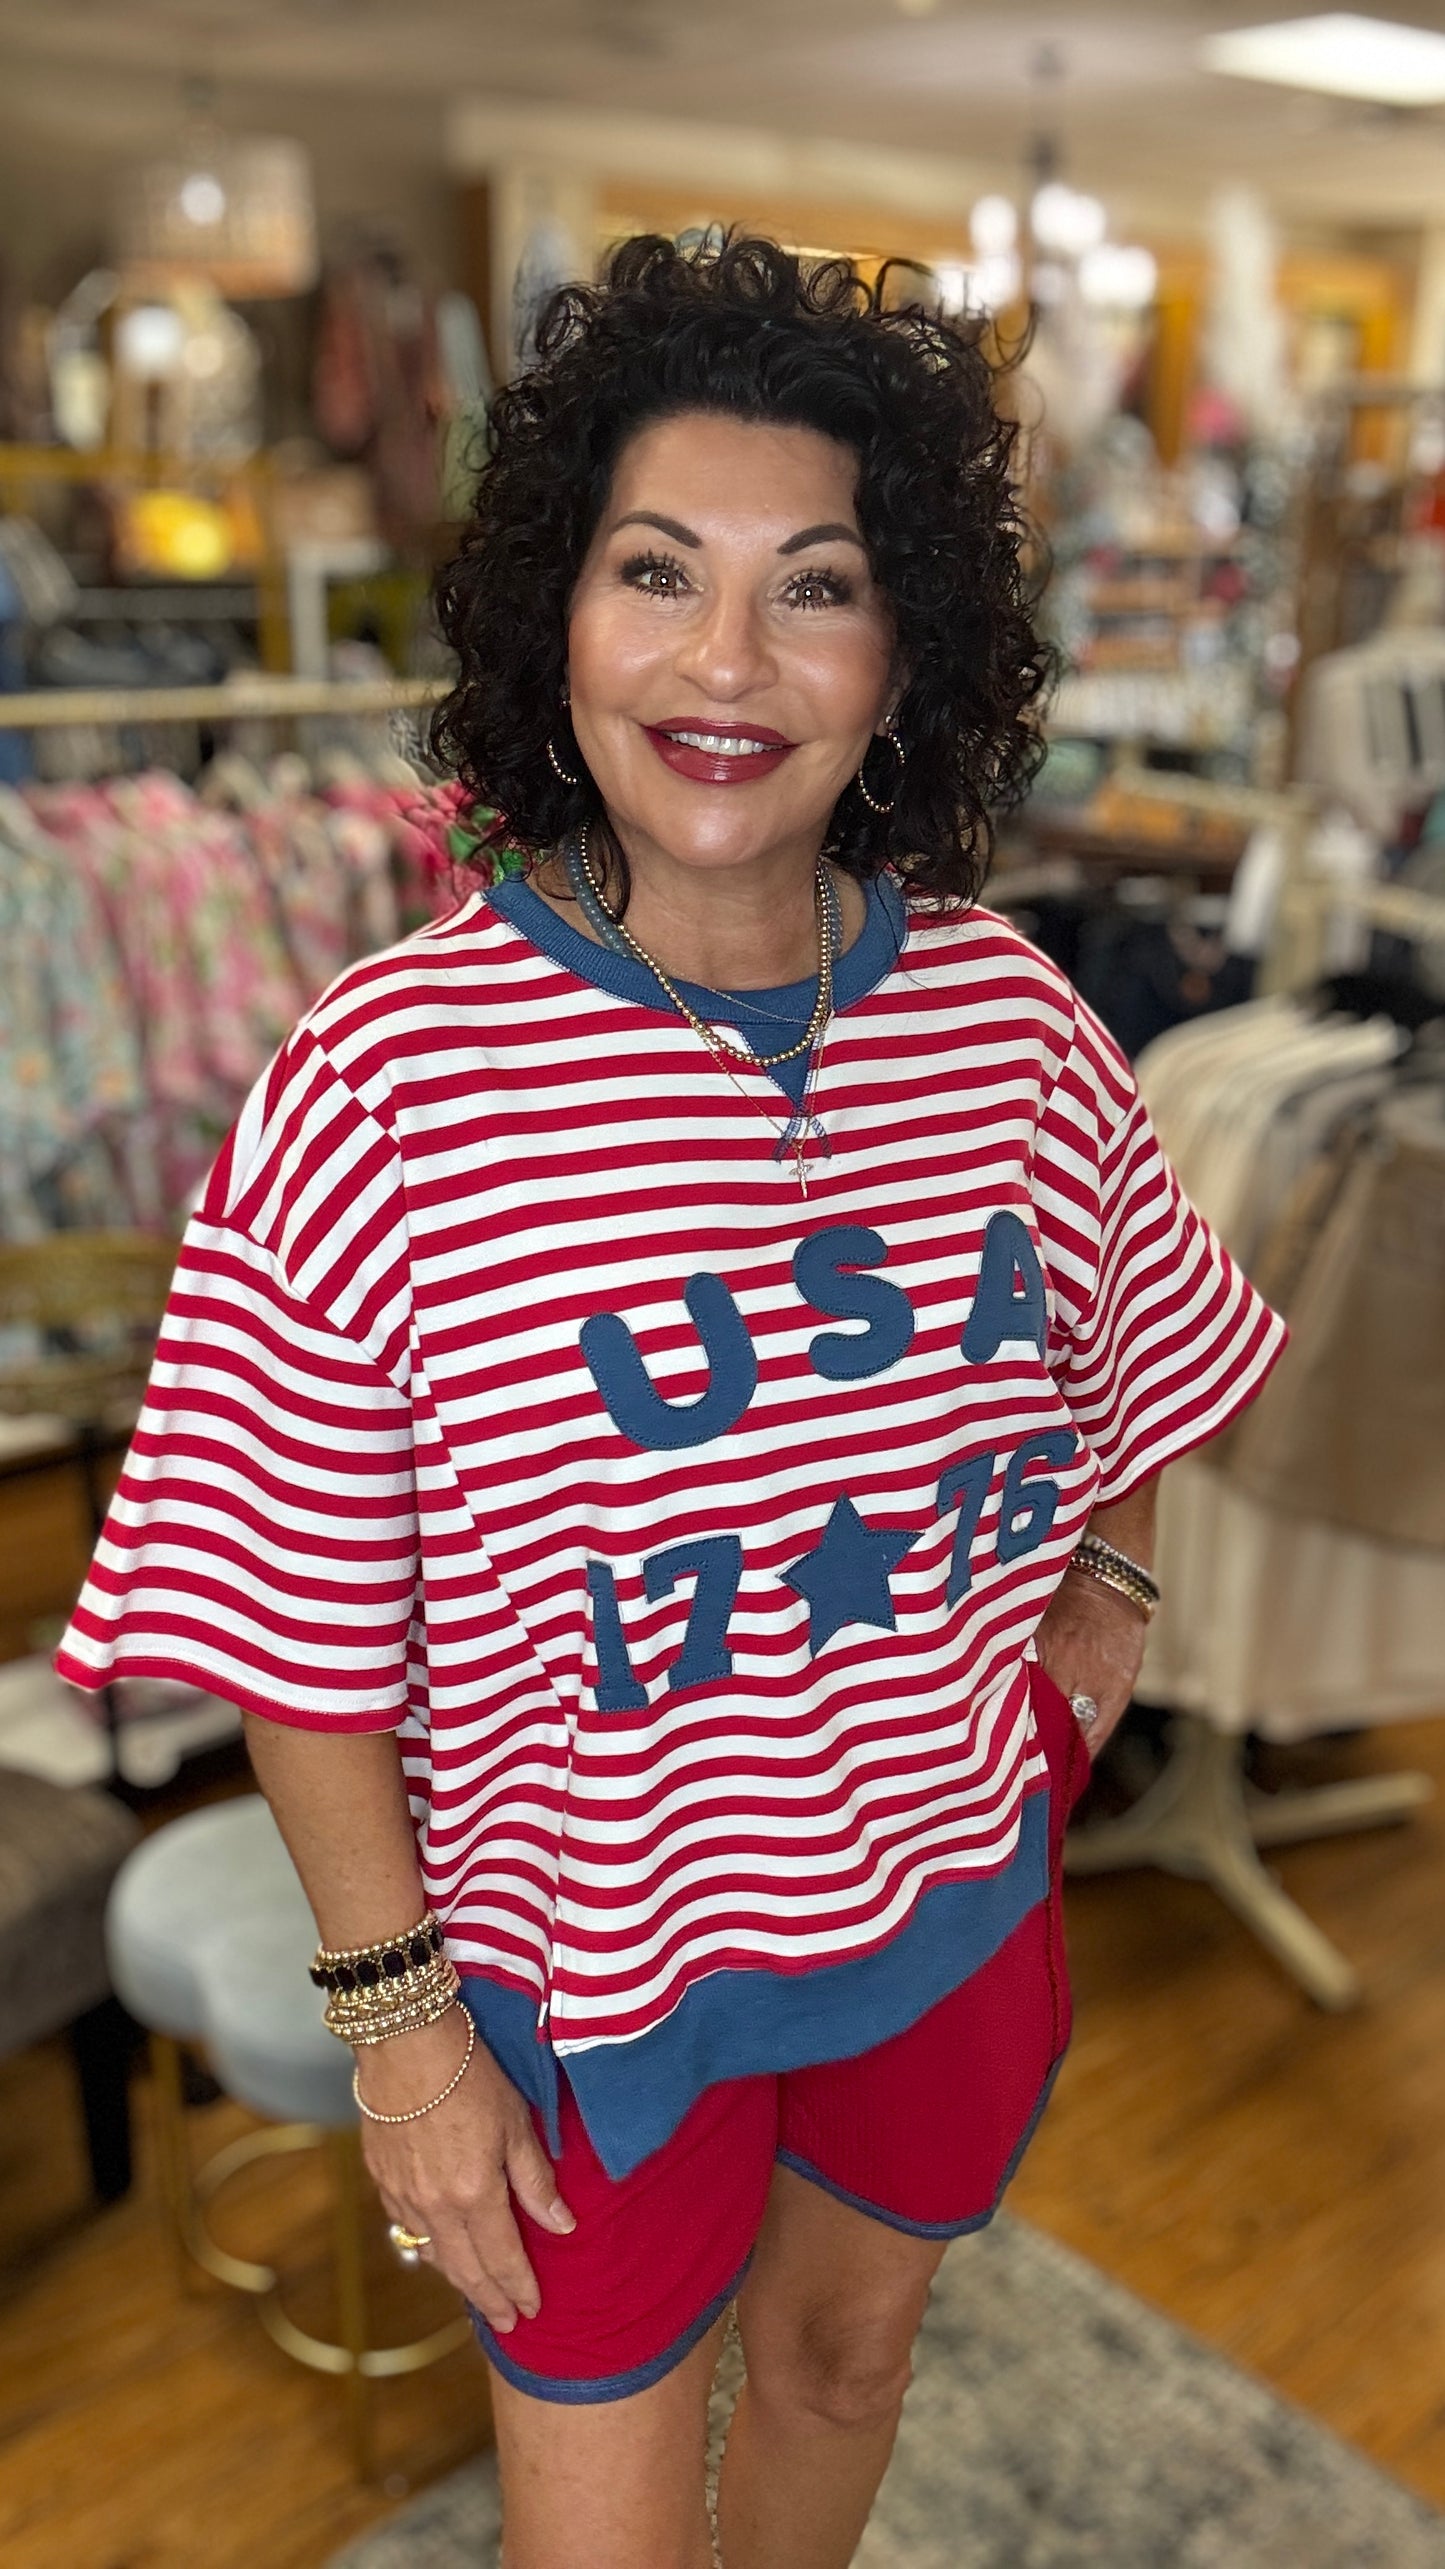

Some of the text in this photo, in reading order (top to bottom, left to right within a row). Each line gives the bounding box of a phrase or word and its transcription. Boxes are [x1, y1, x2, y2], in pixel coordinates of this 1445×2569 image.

[578, 1209, 1047, 1451] USA
[586, 1430, 1080, 1713] 17 76
